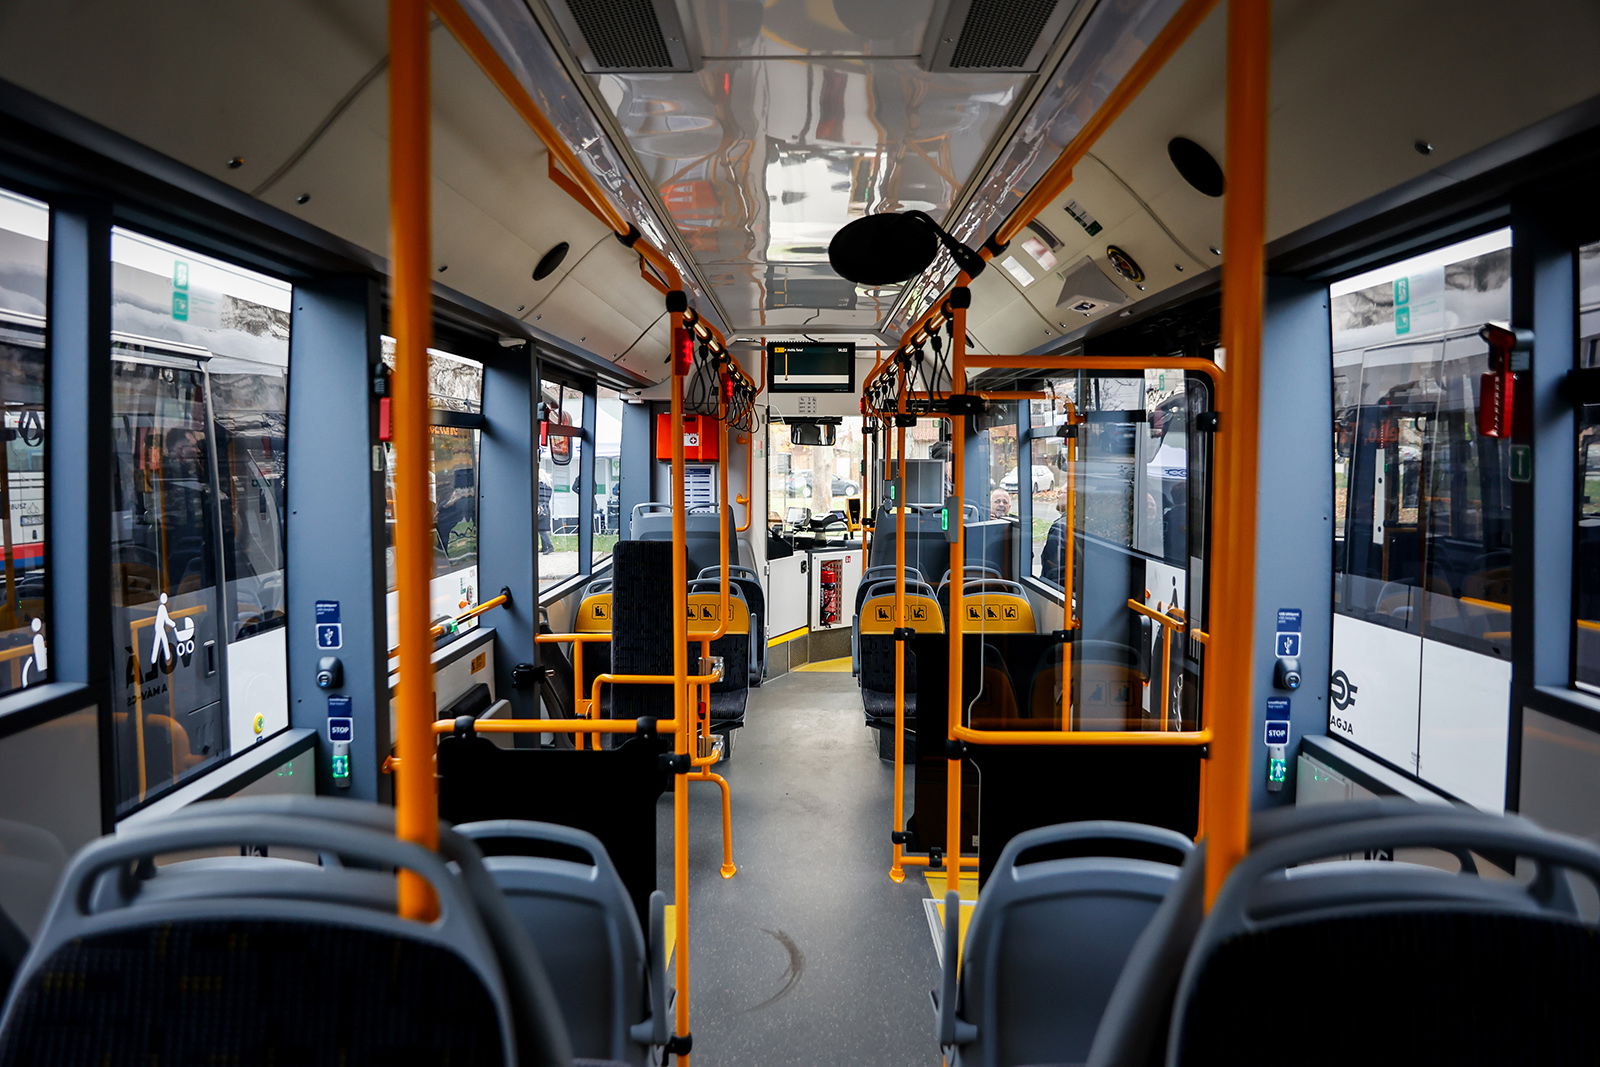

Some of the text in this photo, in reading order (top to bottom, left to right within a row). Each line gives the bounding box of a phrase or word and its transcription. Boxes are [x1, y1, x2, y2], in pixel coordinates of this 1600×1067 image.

[1330, 715, 1354, 735] AGJA
[331, 726, 350, 734] STOP
[1268, 729, 1286, 738] STOP
